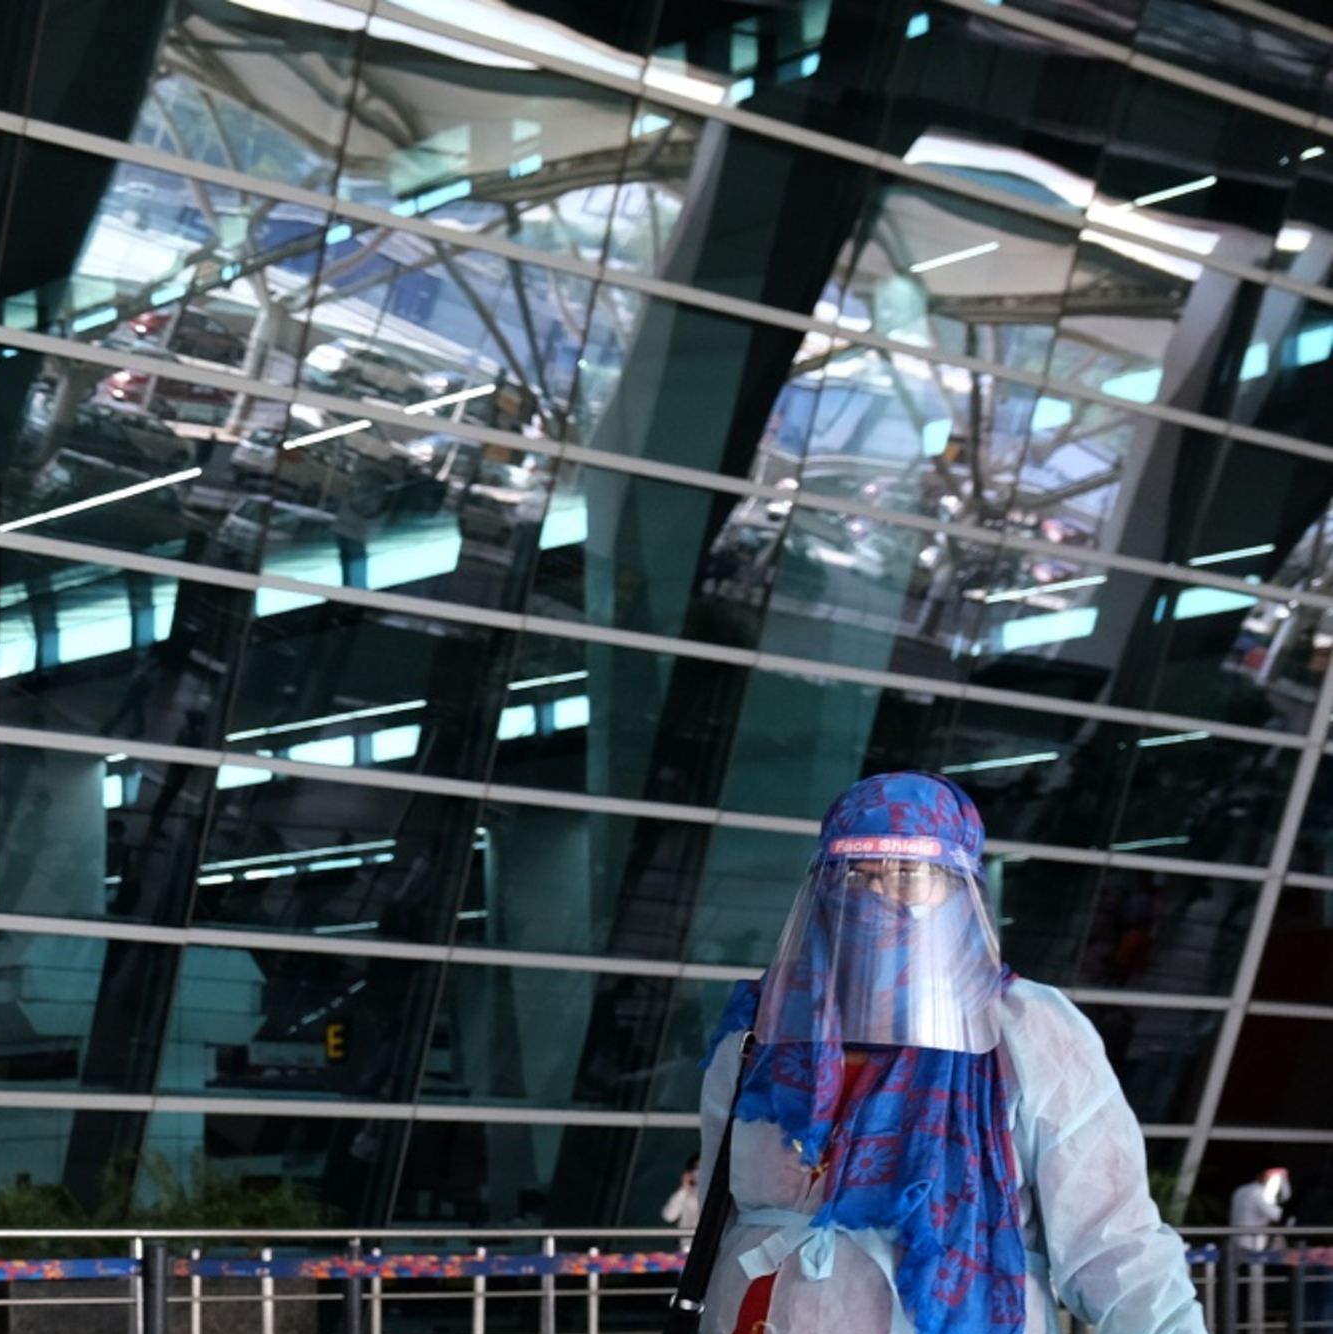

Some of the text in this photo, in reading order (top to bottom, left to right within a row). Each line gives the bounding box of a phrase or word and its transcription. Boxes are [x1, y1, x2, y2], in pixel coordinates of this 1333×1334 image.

[835, 839, 935, 855] Face Shield
[327, 1025, 344, 1058] E
